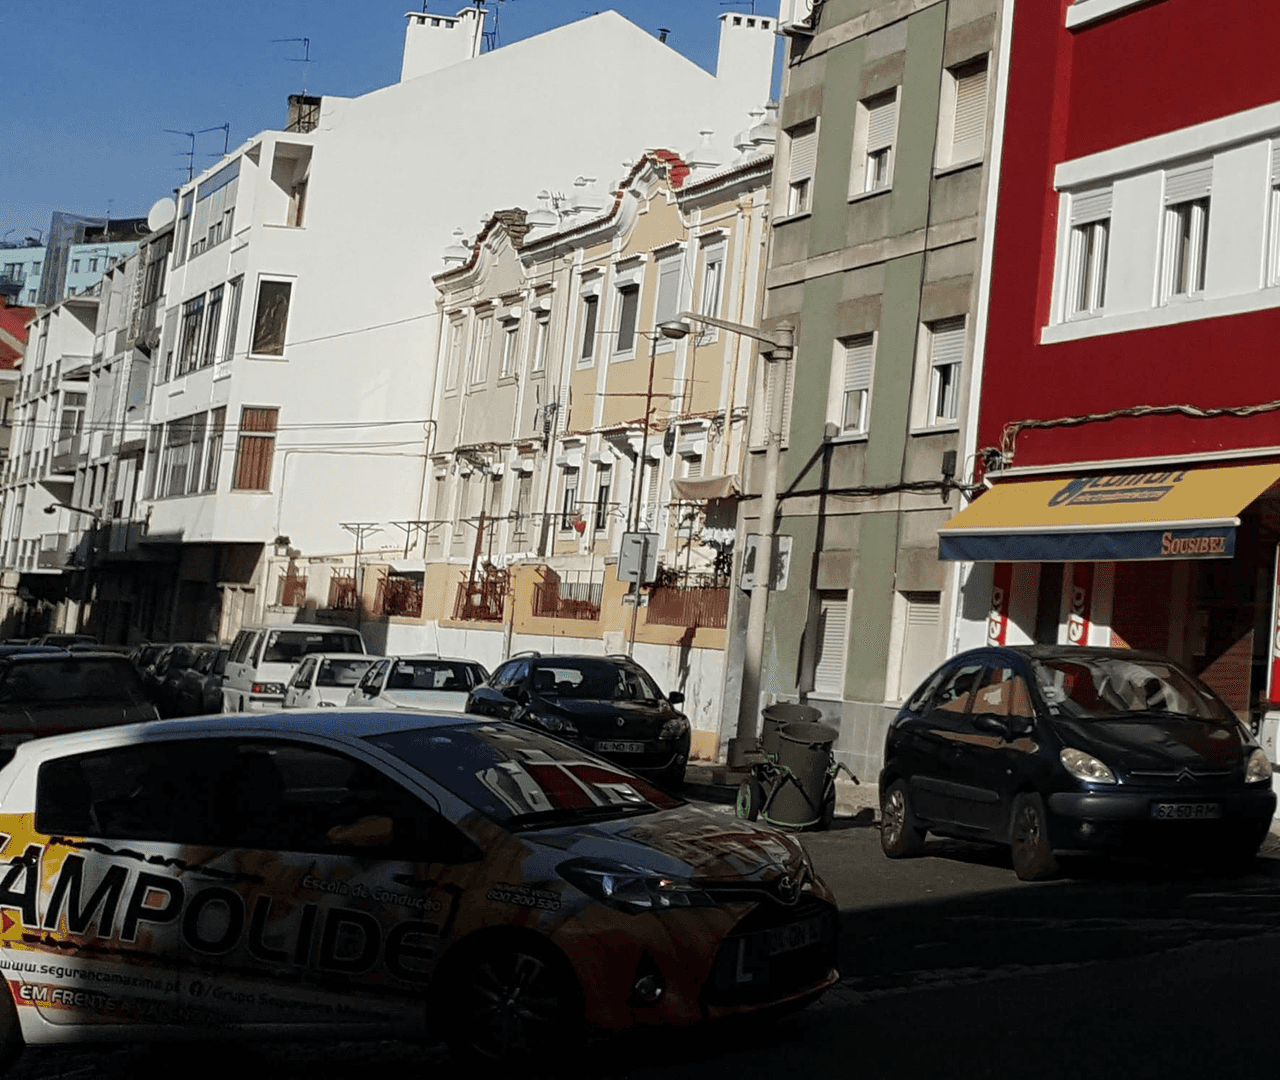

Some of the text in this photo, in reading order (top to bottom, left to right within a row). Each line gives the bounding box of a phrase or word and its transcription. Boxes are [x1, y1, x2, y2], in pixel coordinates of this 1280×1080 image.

[302, 874, 349, 896] Escola
[352, 881, 370, 900] de
[0, 831, 442, 987] AMPOLIDE
[511, 893, 536, 908] 200
[19, 984, 47, 1002] EM
[51, 986, 116, 1011] FRENTE
